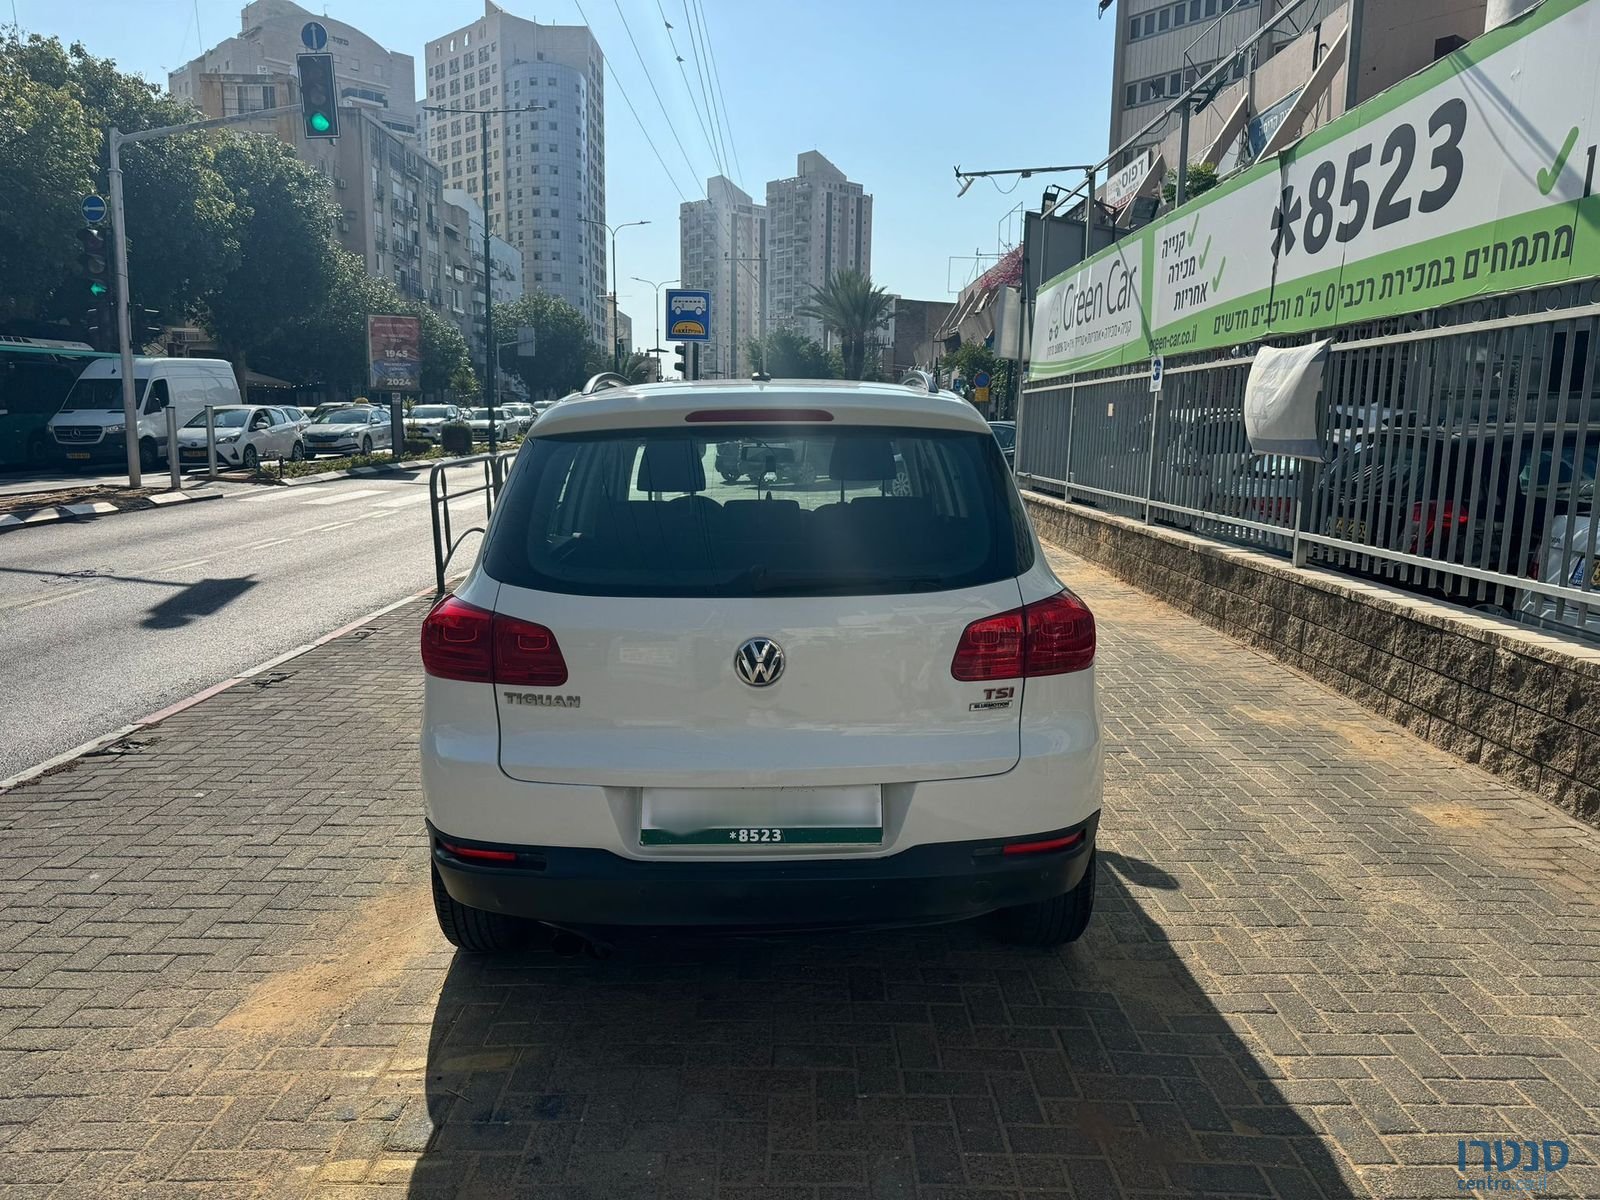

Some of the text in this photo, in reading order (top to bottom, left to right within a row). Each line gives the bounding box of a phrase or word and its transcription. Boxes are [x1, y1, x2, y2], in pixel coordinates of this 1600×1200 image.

[1121, 158, 1145, 188] דפוס
[1161, 230, 1186, 259] קנייה
[1462, 224, 1573, 280] מתמחים
[1168, 255, 1196, 285] מכירה
[1378, 255, 1456, 300] במכירת
[1063, 259, 1137, 331] Green Car
[1173, 281, 1209, 312] אחריות
[1340, 277, 1375, 308] רכבי
[1213, 308, 1249, 336] חדשים
[1251, 298, 1291, 327] ורכבים
[384, 349, 408, 358] 1945
[386, 378, 412, 386] 2024
[503, 691, 581, 709] TIGUAN
[983, 687, 1015, 701] TSI
